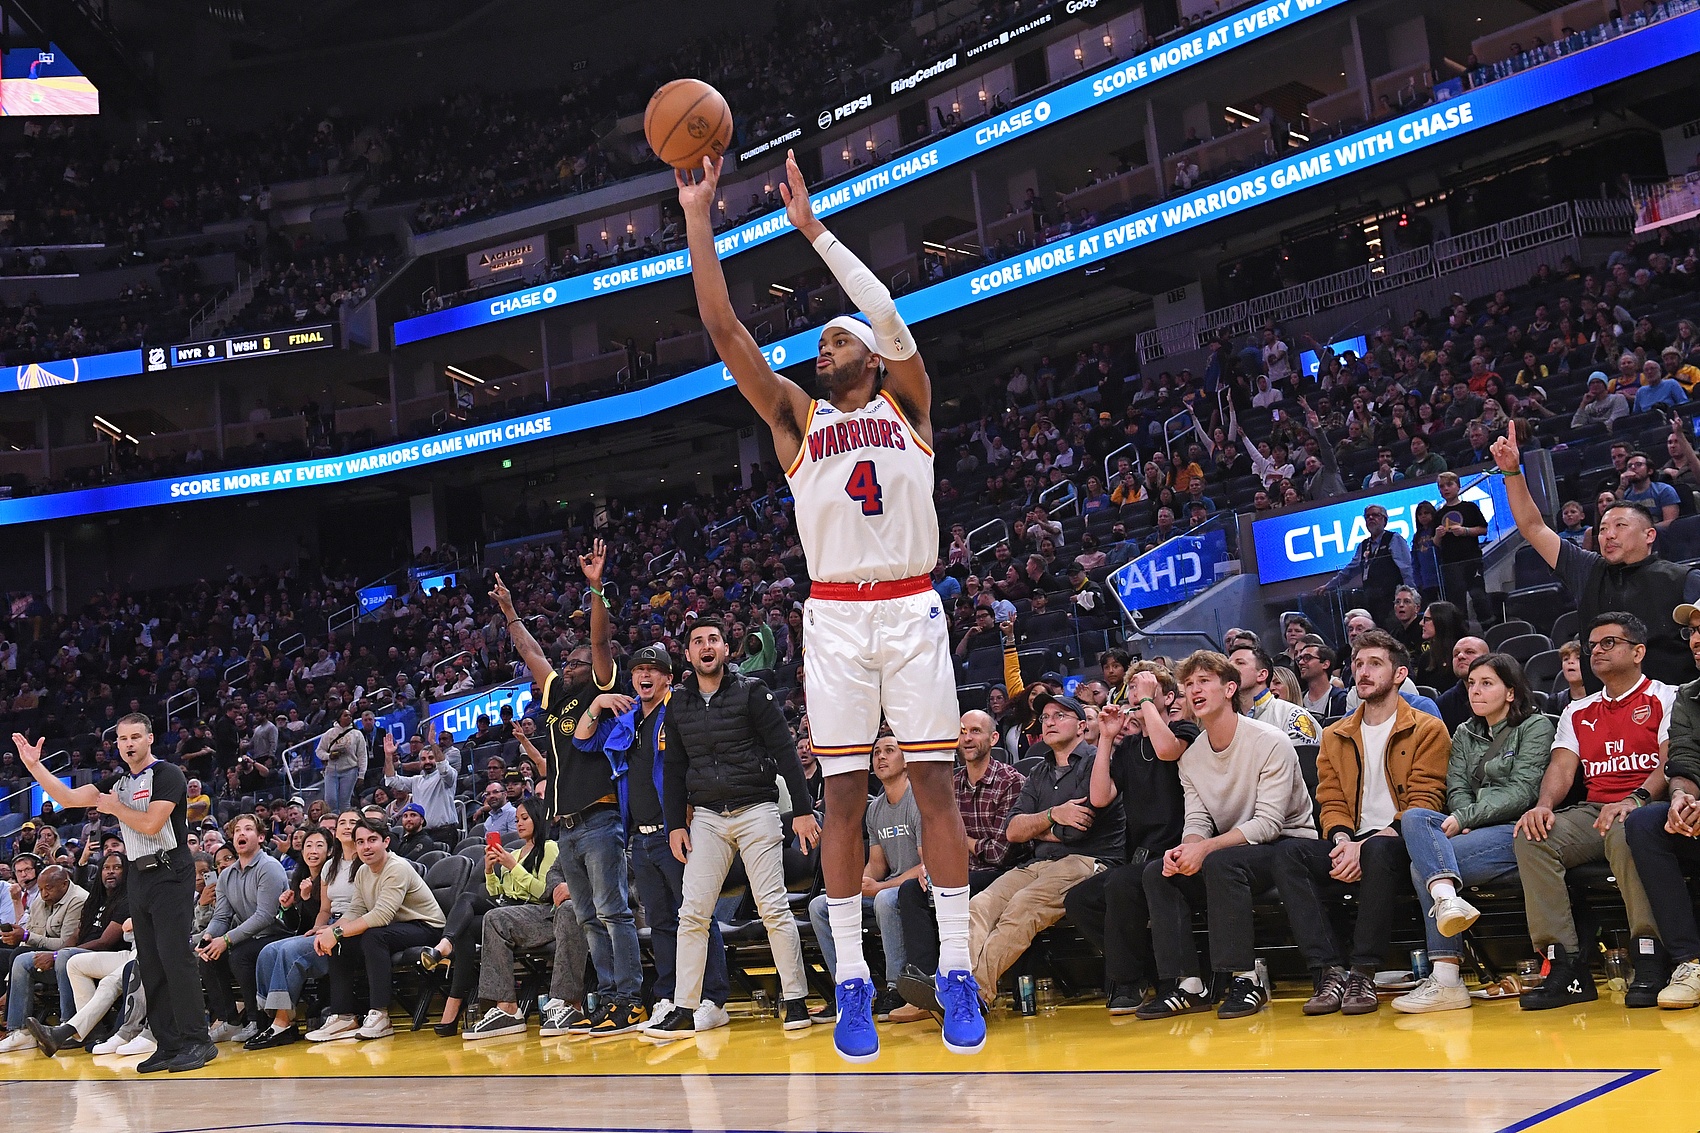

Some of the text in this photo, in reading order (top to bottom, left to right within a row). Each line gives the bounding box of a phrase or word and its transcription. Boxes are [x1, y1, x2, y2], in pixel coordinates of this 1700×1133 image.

[1066, 0, 1098, 14] Goog
[967, 15, 1051, 56] UNITED AIRLINES
[1093, 0, 1290, 96] SCORE MORE AT EVERY
[891, 54, 956, 94] RingCentral
[835, 94, 871, 120] PEPSI
[976, 110, 1032, 144] CHASE
[741, 129, 801, 160] FOUNDING PARTNERS
[971, 103, 1473, 294] SCORE MORE AT EVERY WARRIORS GAME WITH CHASE
[593, 268, 638, 290] SCORE
[642, 256, 684, 278] MORE
[811, 188, 850, 214] GAME
[852, 171, 889, 197] WITH
[892, 150, 938, 180] CHASE
[491, 294, 541, 315] CHASE
[179, 345, 215, 360] NYR 3
[233, 338, 270, 352] WSH 5
[289, 332, 323, 345] FINAL
[807, 417, 906, 463] WARRIORS
[171, 417, 551, 497] SCORE MORE AT EVERY WARRIORS GAME WITH CHASE
[845, 460, 883, 516] 4
[1605, 739, 1624, 755] Fly
[1581, 752, 1660, 777] Emirates
